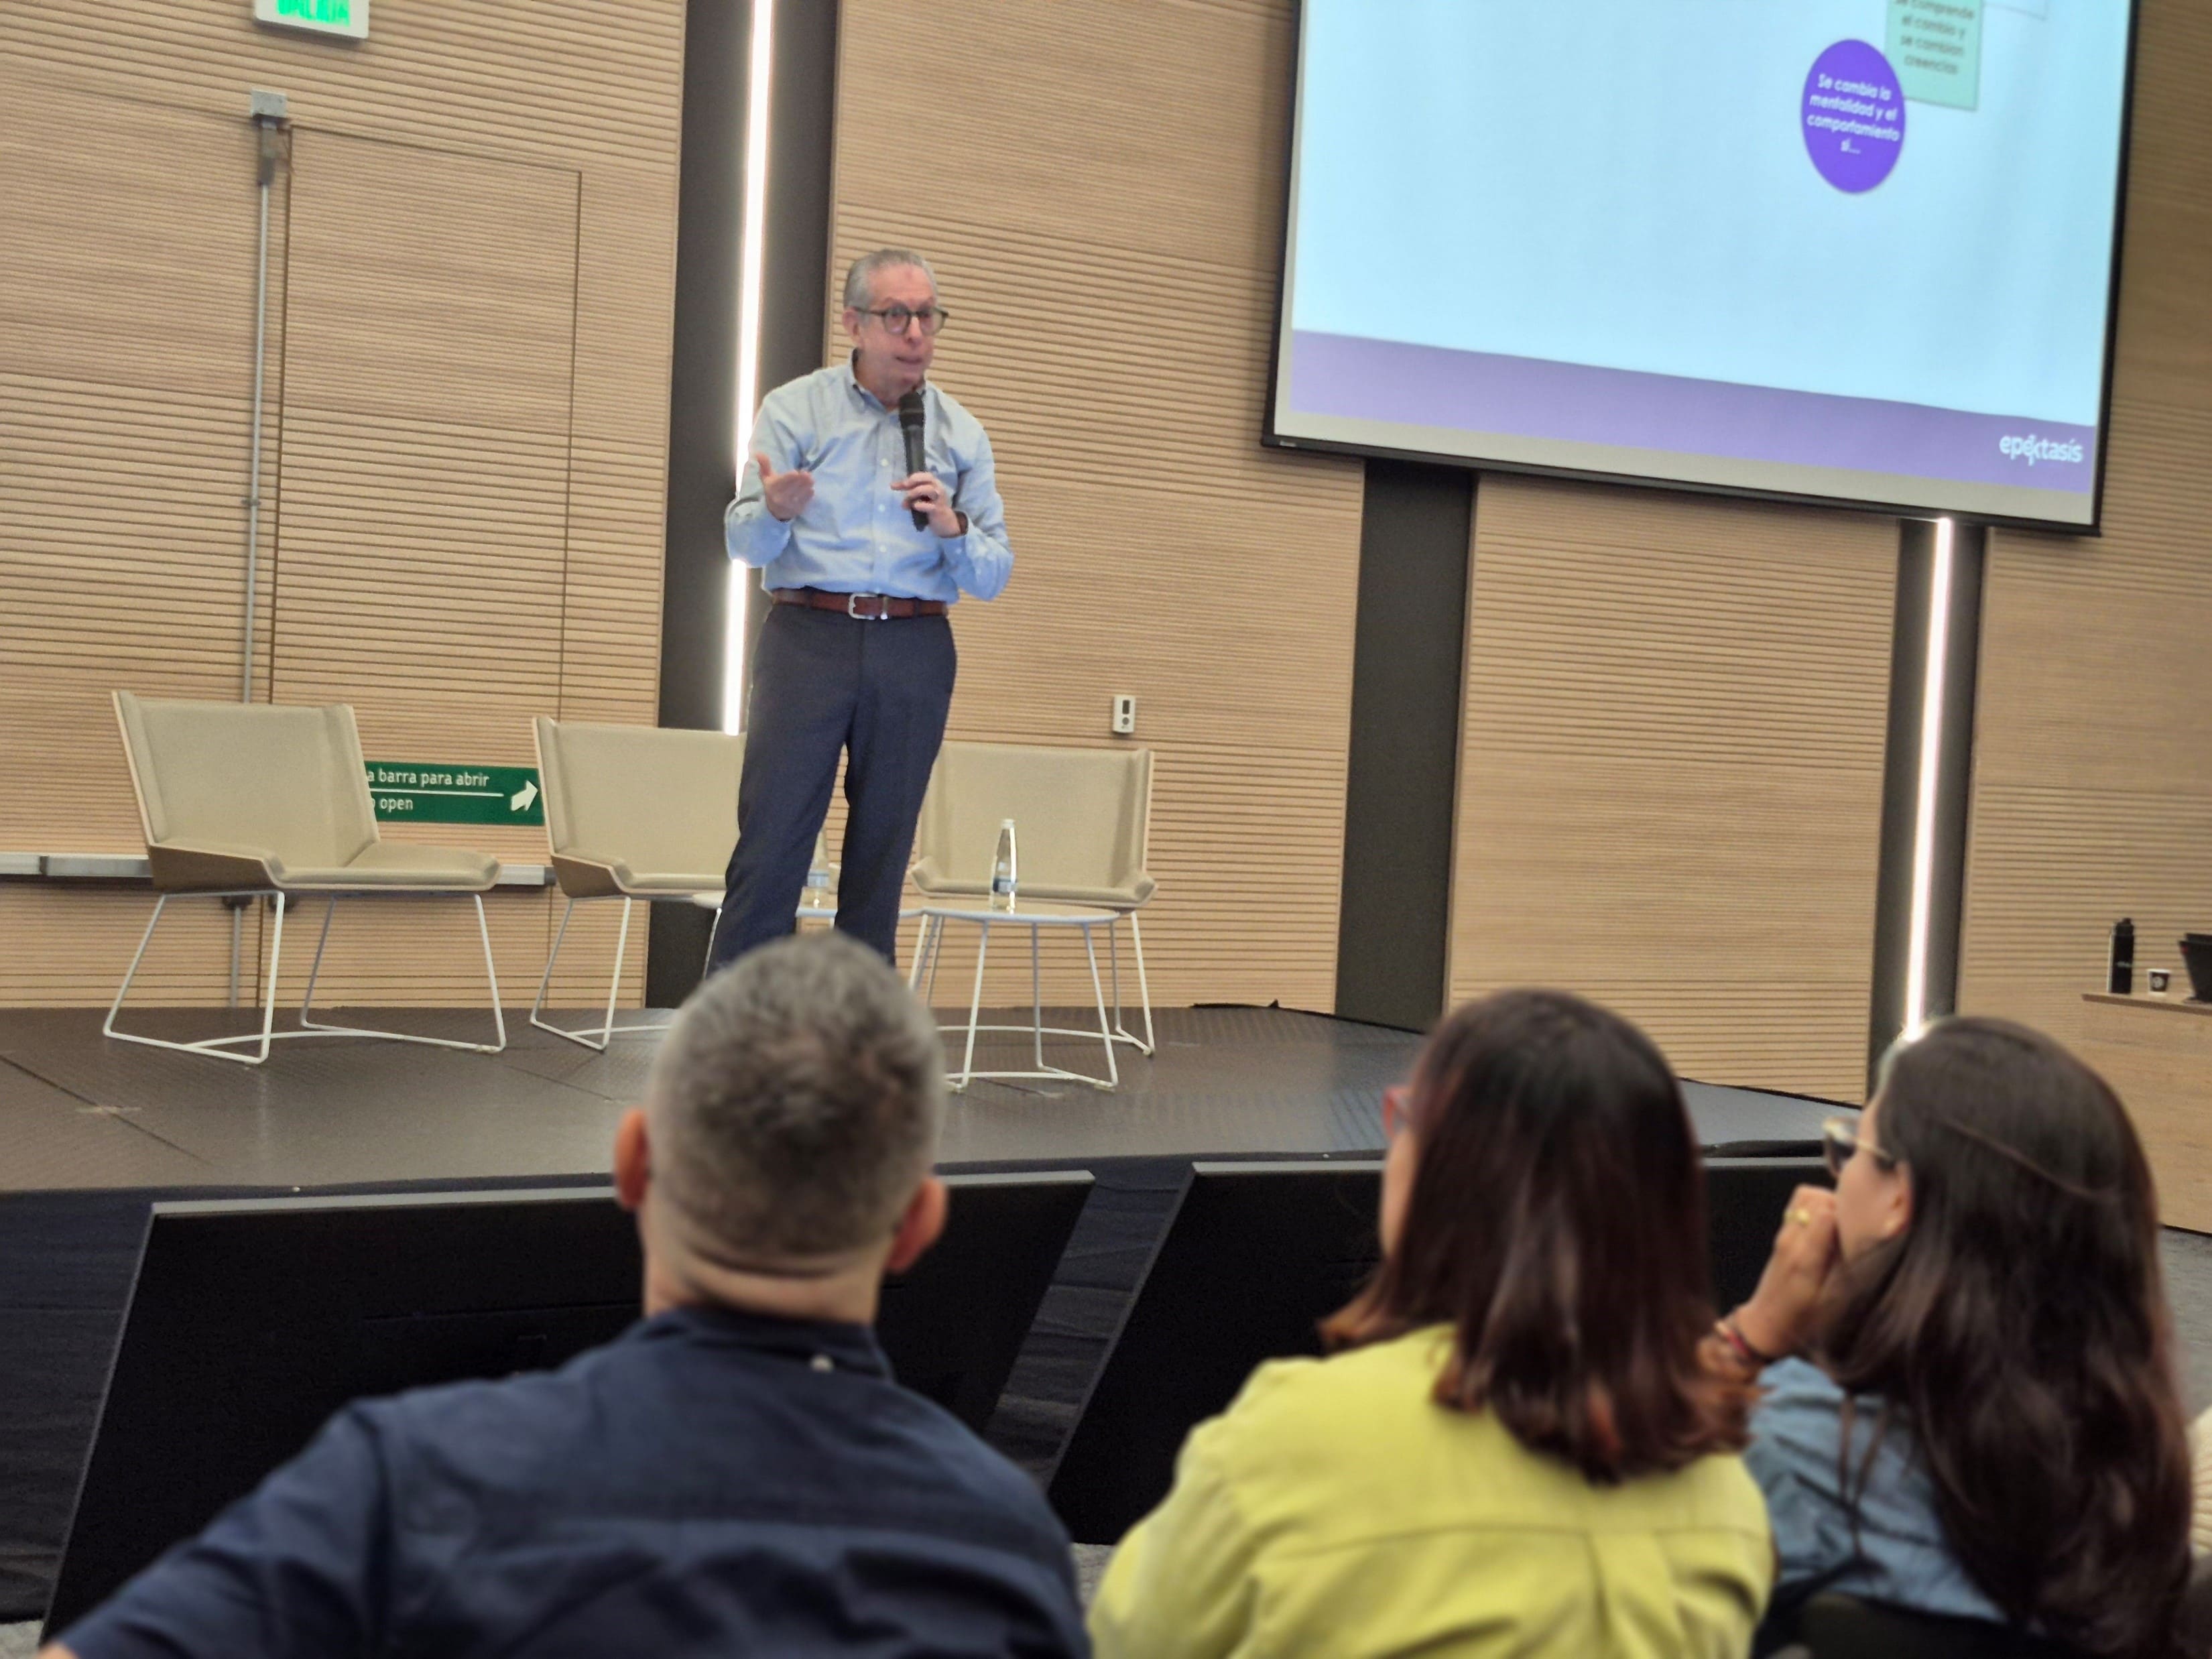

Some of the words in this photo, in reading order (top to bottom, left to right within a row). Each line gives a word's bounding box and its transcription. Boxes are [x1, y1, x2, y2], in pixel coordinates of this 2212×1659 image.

[1818, 73, 1833, 89] Se
[1834, 79, 1878, 99] cambia
[1809, 94, 1876, 117] mentalidad
[1875, 108, 1884, 122] y
[1884, 107, 1898, 121] el
[1806, 114, 1900, 142] comportamiento
[378, 767, 417, 784] barra
[420, 772, 452, 788] para
[456, 772, 489, 787] abrir
[379, 798, 414, 813] open
